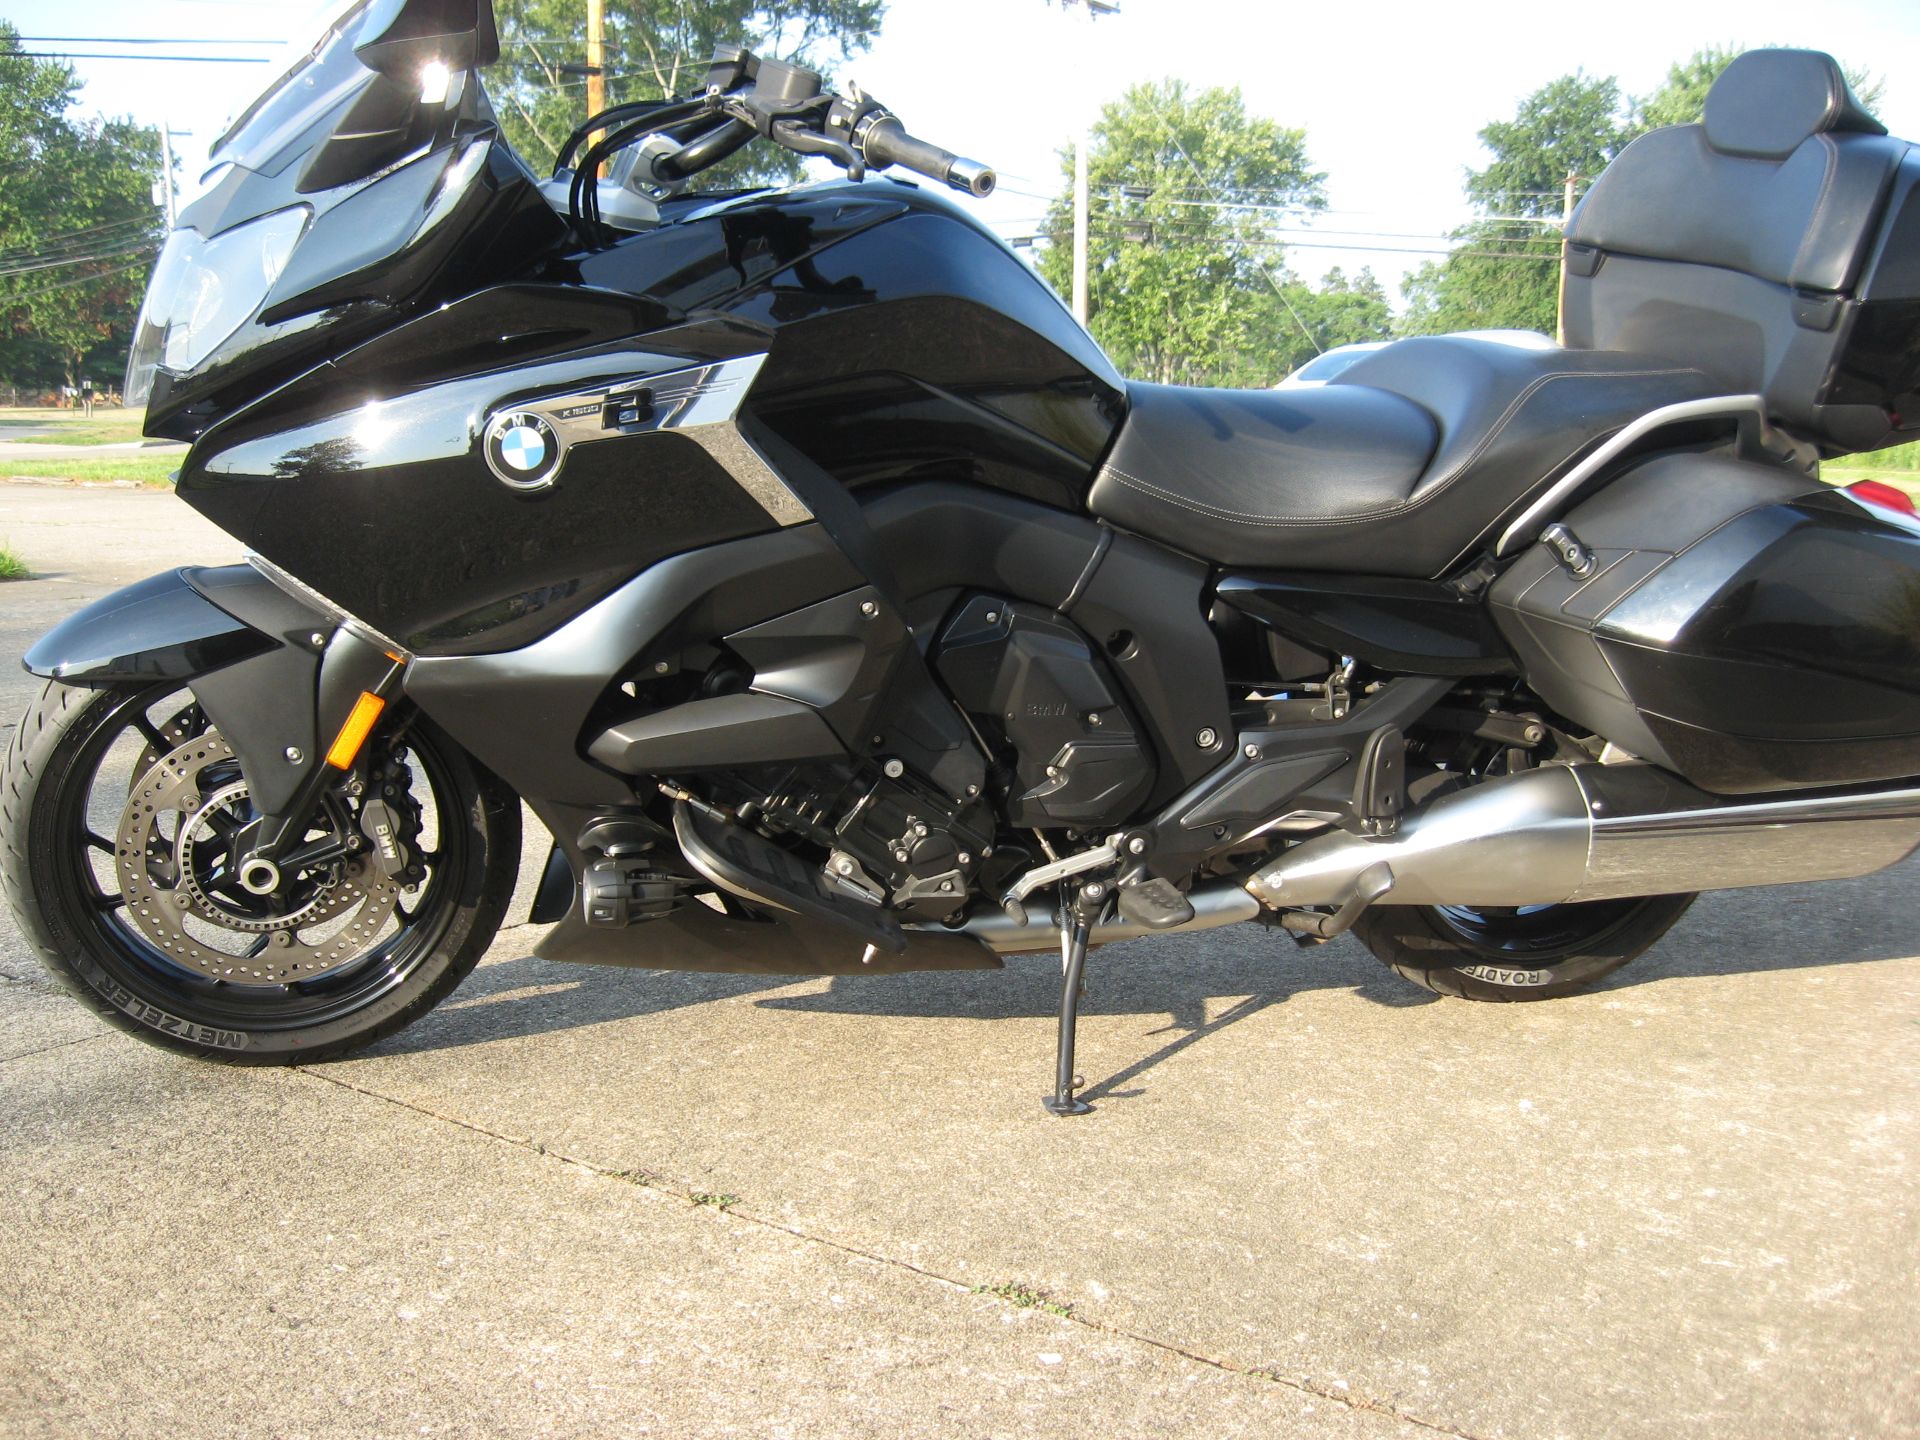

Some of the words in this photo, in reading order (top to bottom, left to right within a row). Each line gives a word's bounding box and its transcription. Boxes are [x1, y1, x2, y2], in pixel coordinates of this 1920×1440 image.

[492, 414, 549, 440] BMW
[375, 823, 397, 859] BMW
[98, 975, 242, 1049] METZELER
